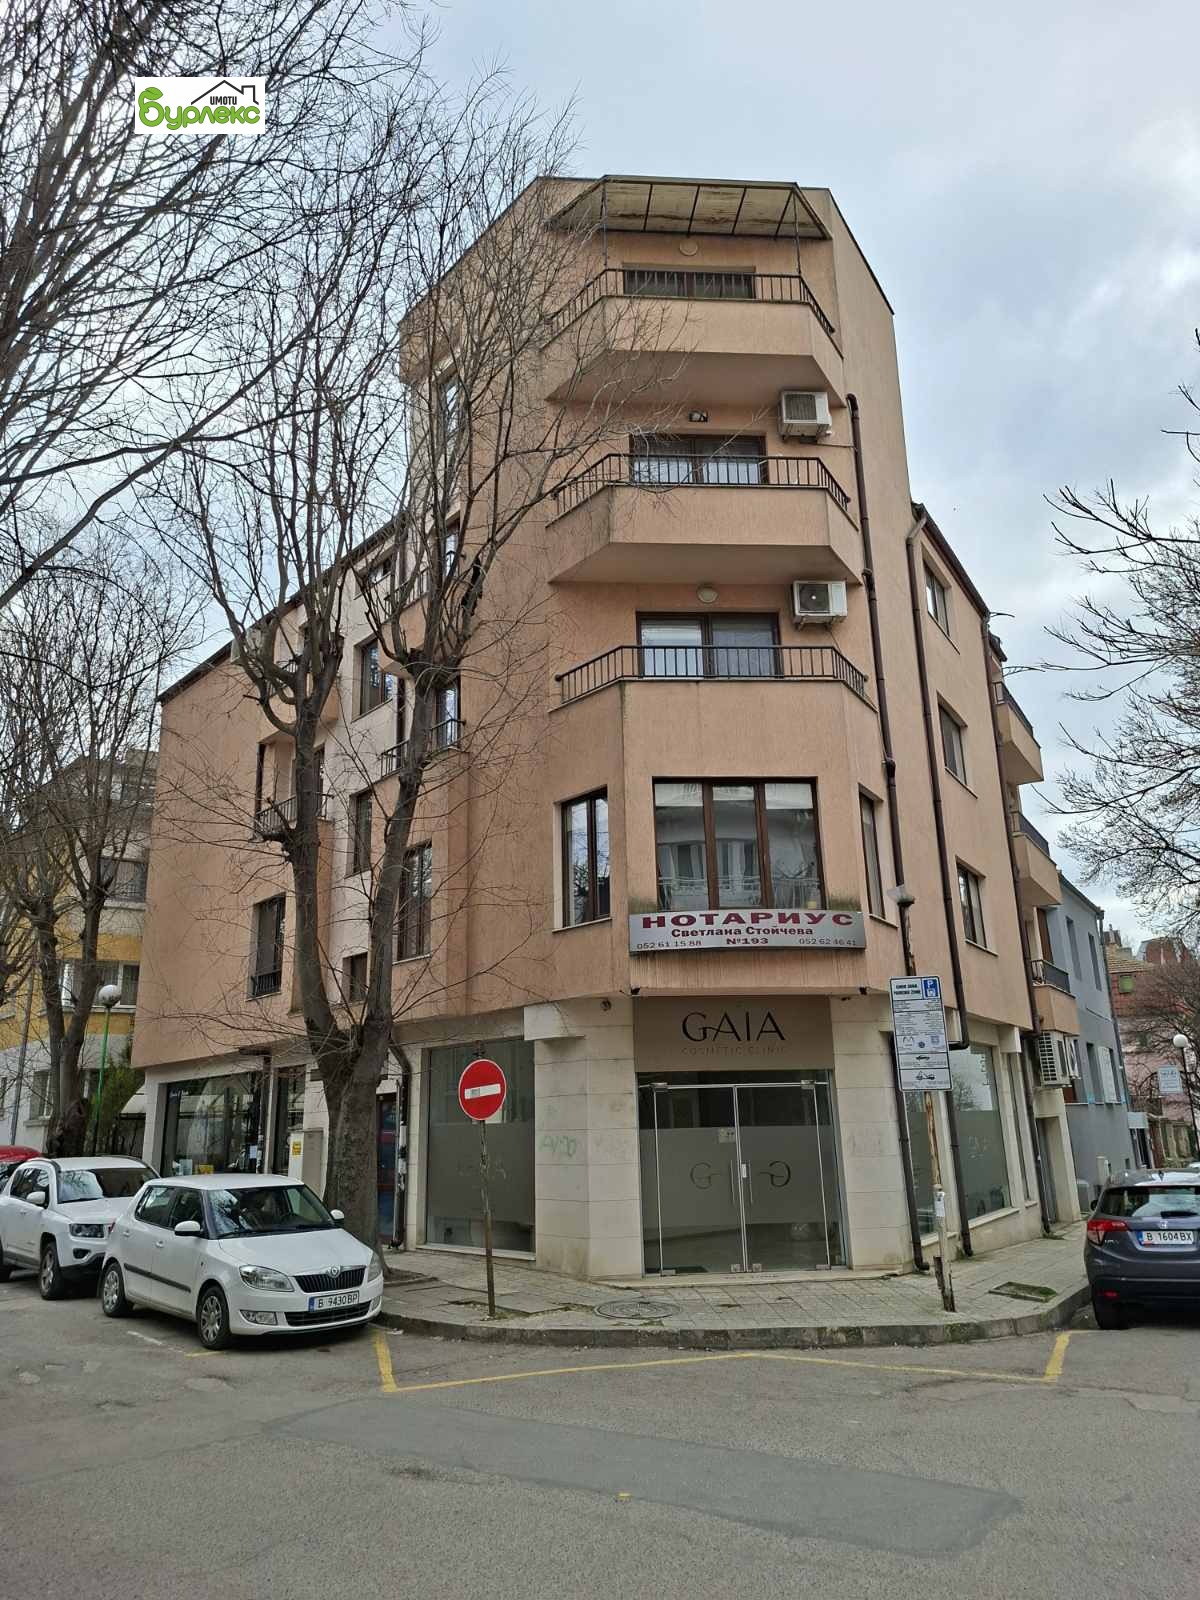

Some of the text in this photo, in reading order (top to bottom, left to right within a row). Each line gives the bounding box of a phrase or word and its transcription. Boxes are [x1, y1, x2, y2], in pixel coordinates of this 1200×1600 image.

[642, 911, 853, 929] НОТАРИУС
[671, 925, 813, 938] Светлана Стойчева
[636, 941, 656, 950] 052
[681, 1011, 786, 1042] GAIA
